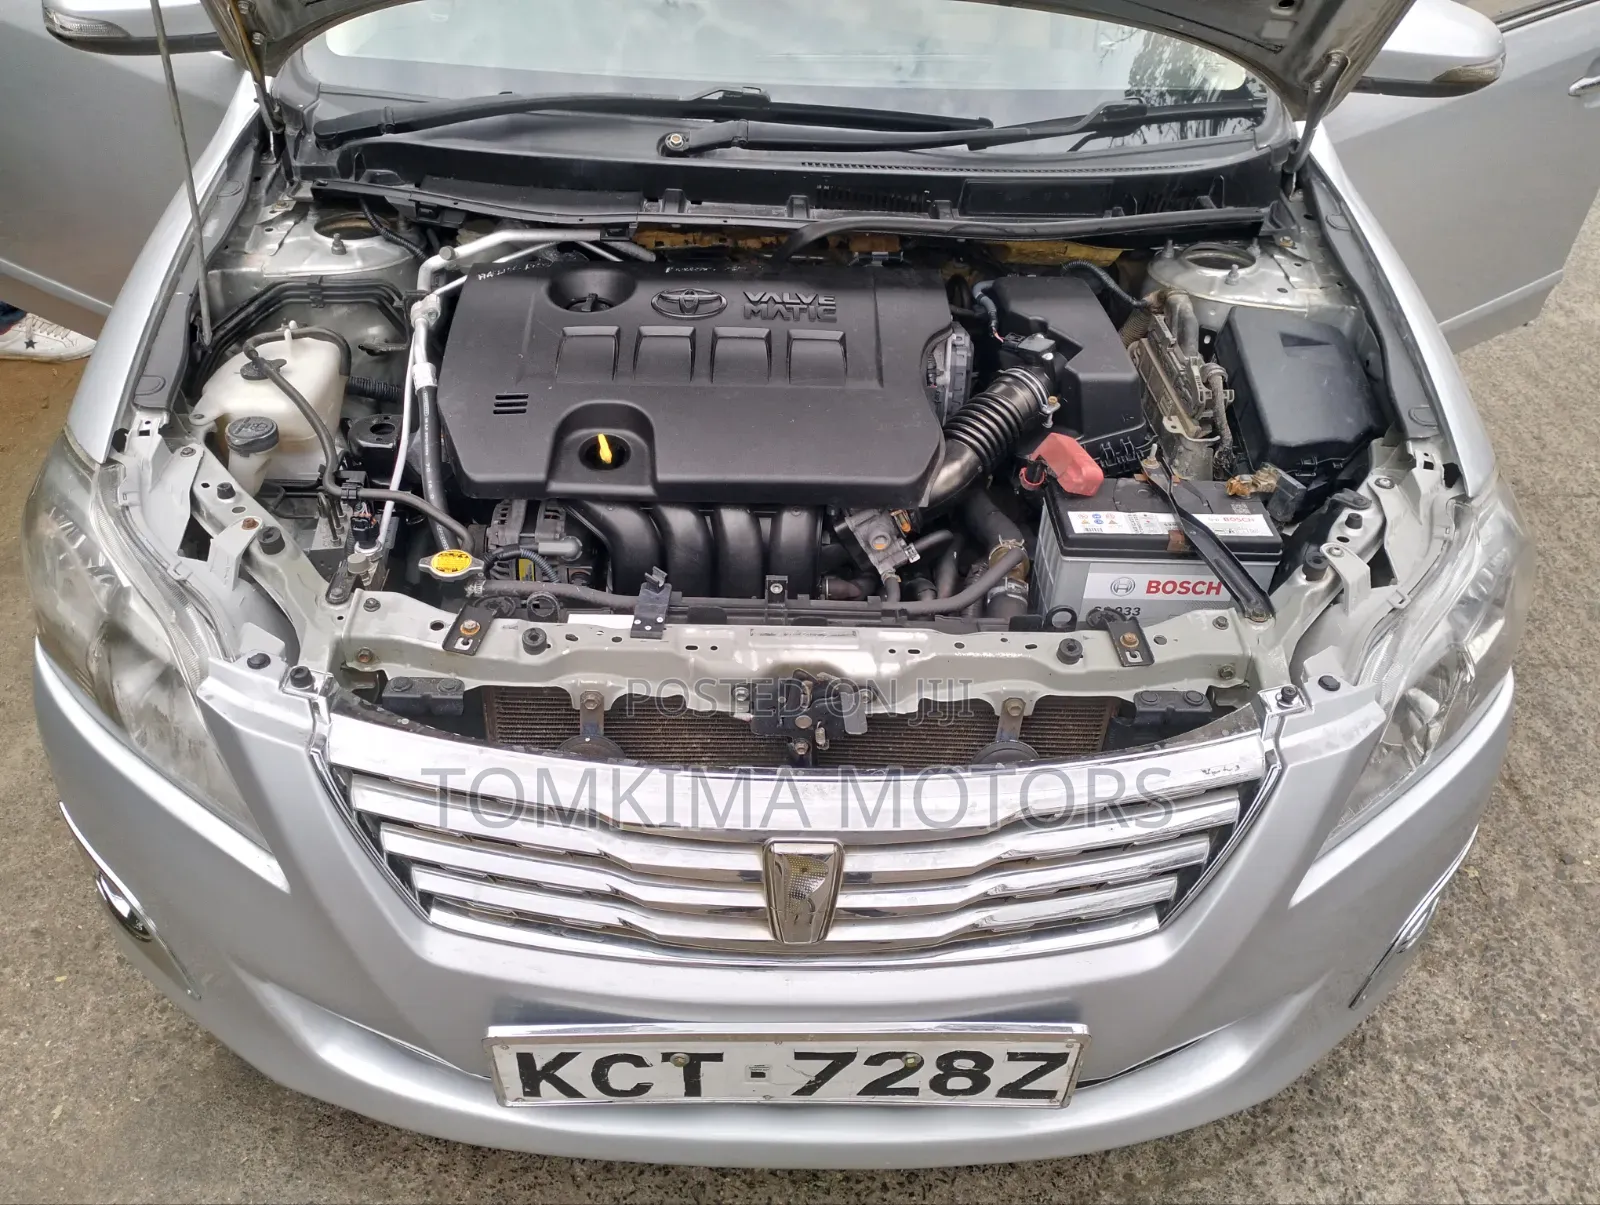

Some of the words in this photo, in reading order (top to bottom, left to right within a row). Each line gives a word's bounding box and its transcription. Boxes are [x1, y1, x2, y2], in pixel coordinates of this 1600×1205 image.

[743, 291, 836, 305] VALVE
[743, 303, 838, 322] MATIC
[1145, 579, 1223, 596] BOSCH
[516, 1051, 724, 1098] KCT
[791, 1050, 1070, 1099] 728Z
